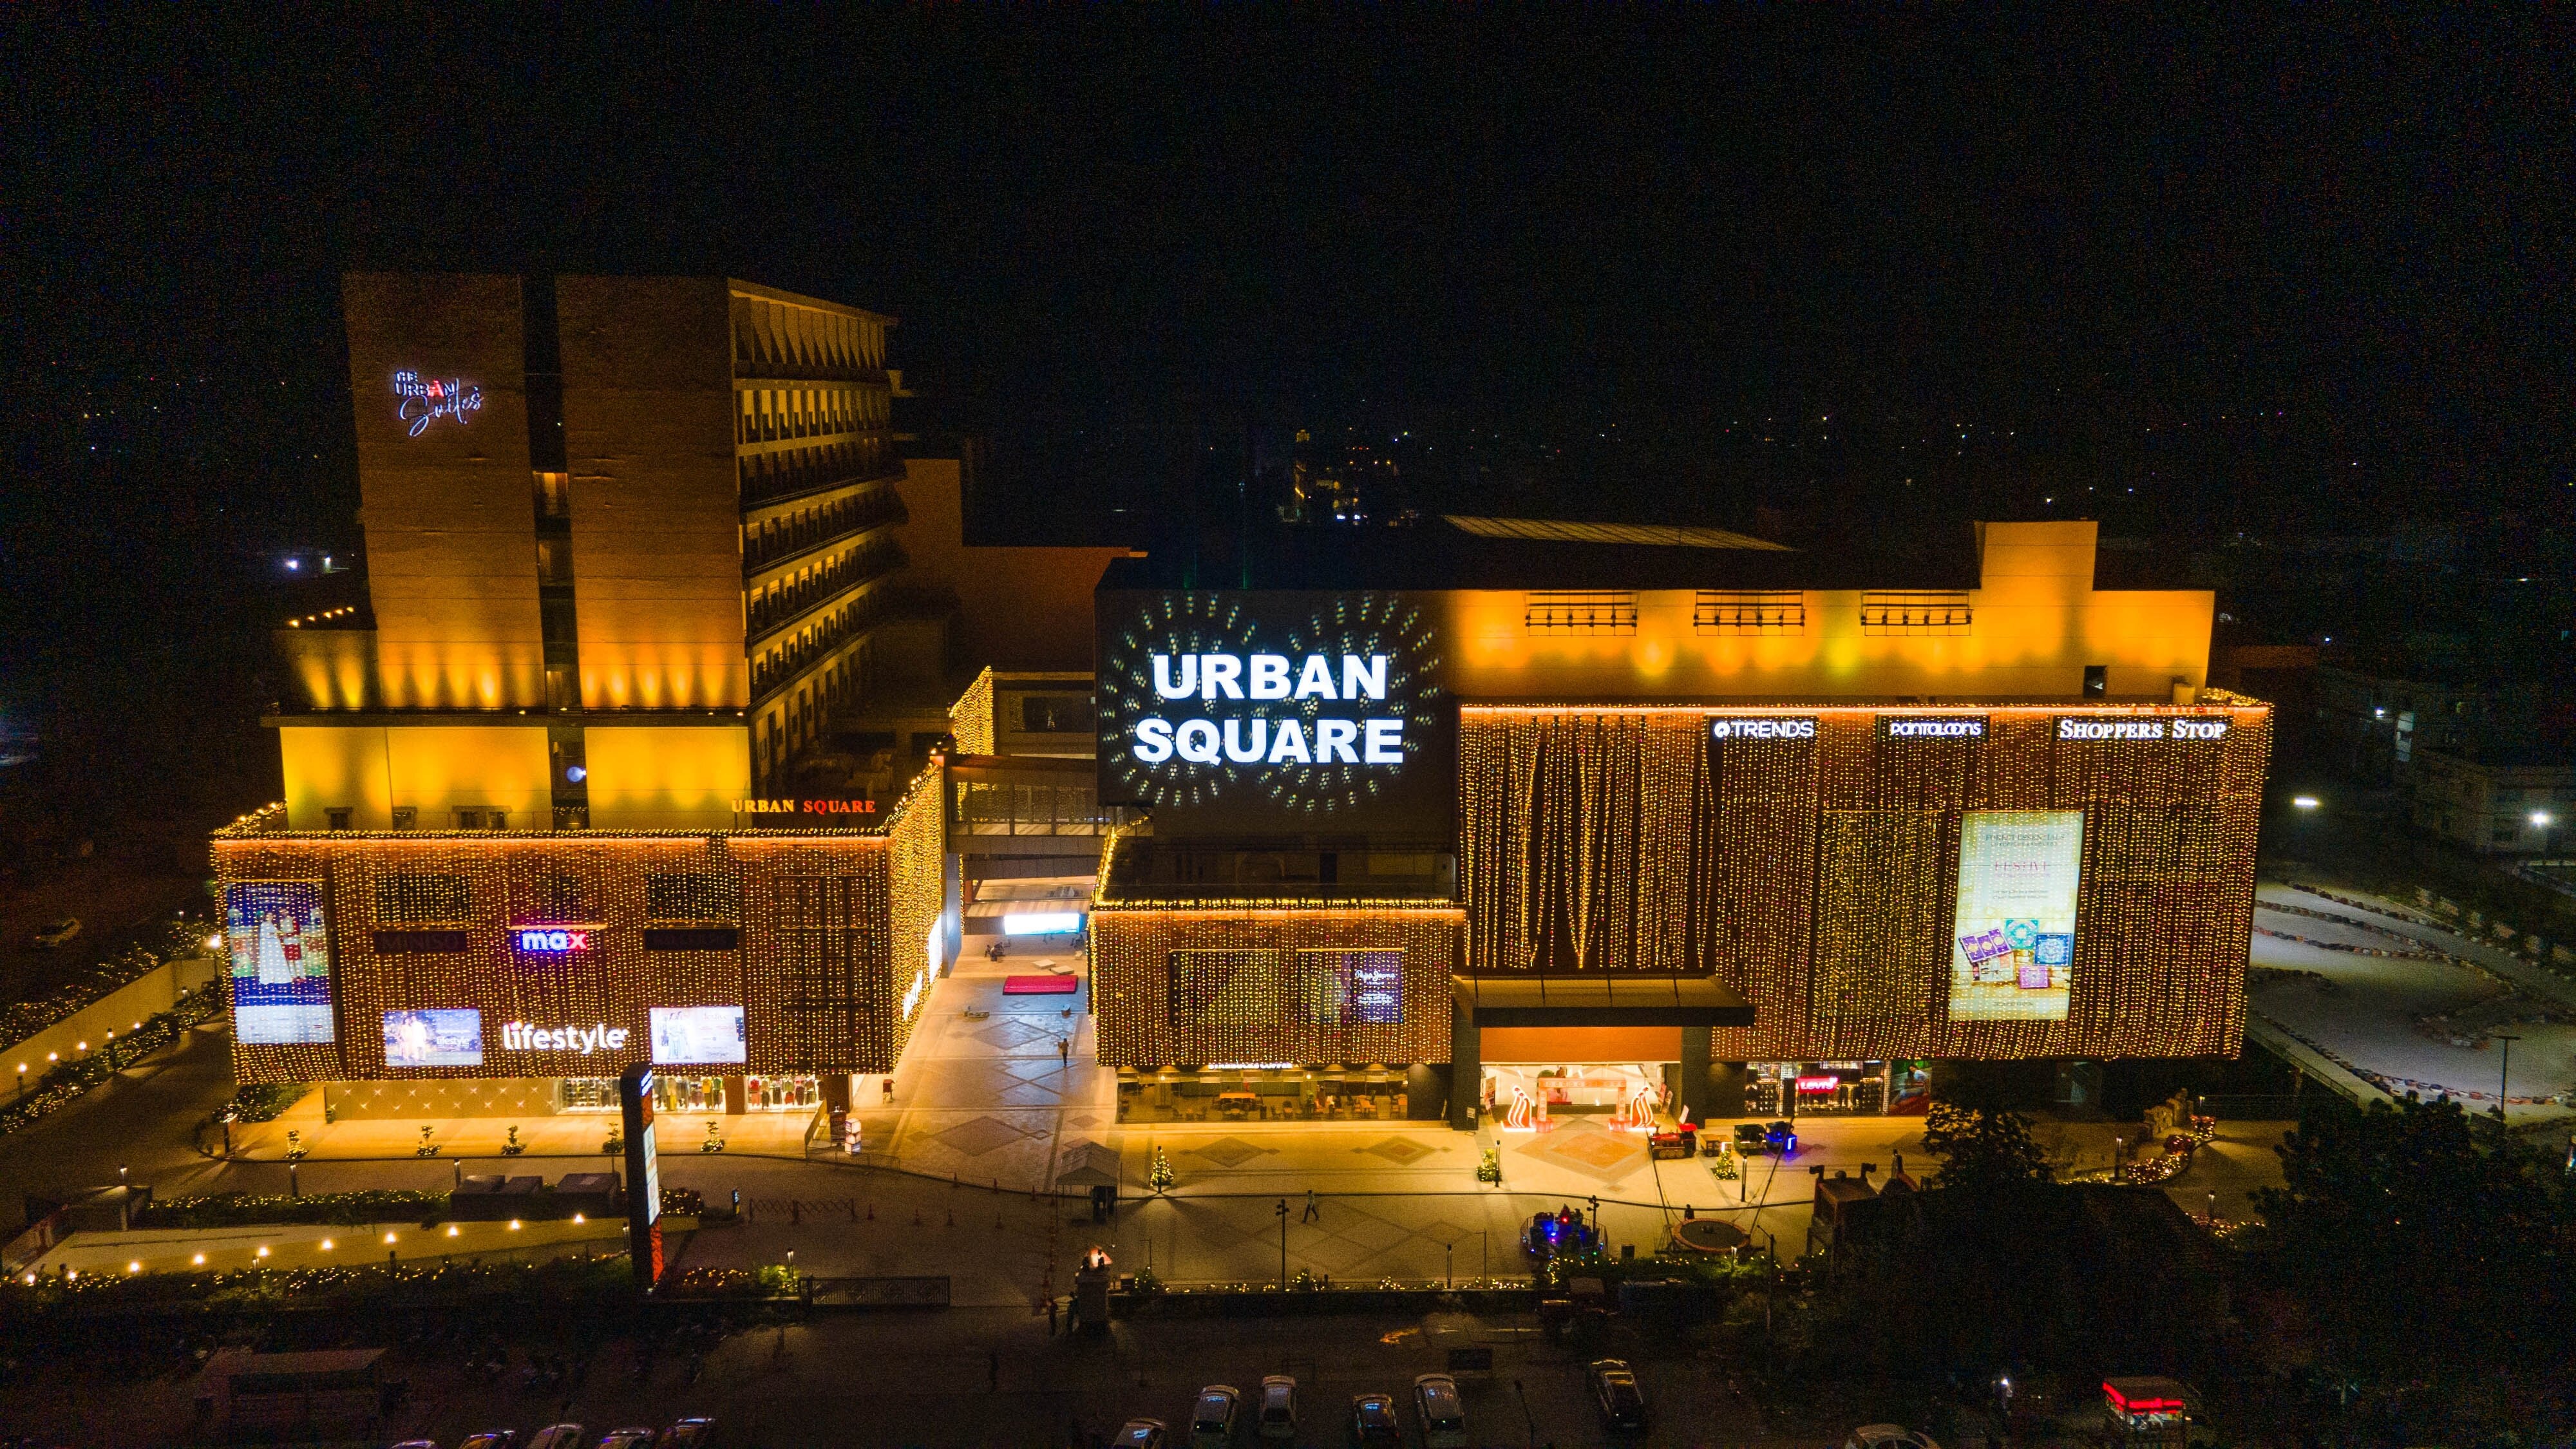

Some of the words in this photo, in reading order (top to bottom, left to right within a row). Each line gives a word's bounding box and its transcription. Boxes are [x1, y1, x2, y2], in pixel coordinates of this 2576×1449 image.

[395, 380, 455, 397] URBAN
[399, 378, 485, 437] Suites
[1153, 654, 1387, 699] URBAN
[1730, 721, 1815, 737] TRENDS
[1133, 718, 1404, 766] SQUARE
[731, 799, 795, 813] URBAN
[803, 800, 876, 815] SQUARE
[381, 934, 459, 949] MINISO
[522, 932, 588, 950] max
[502, 1021, 627, 1055] lifestyle
